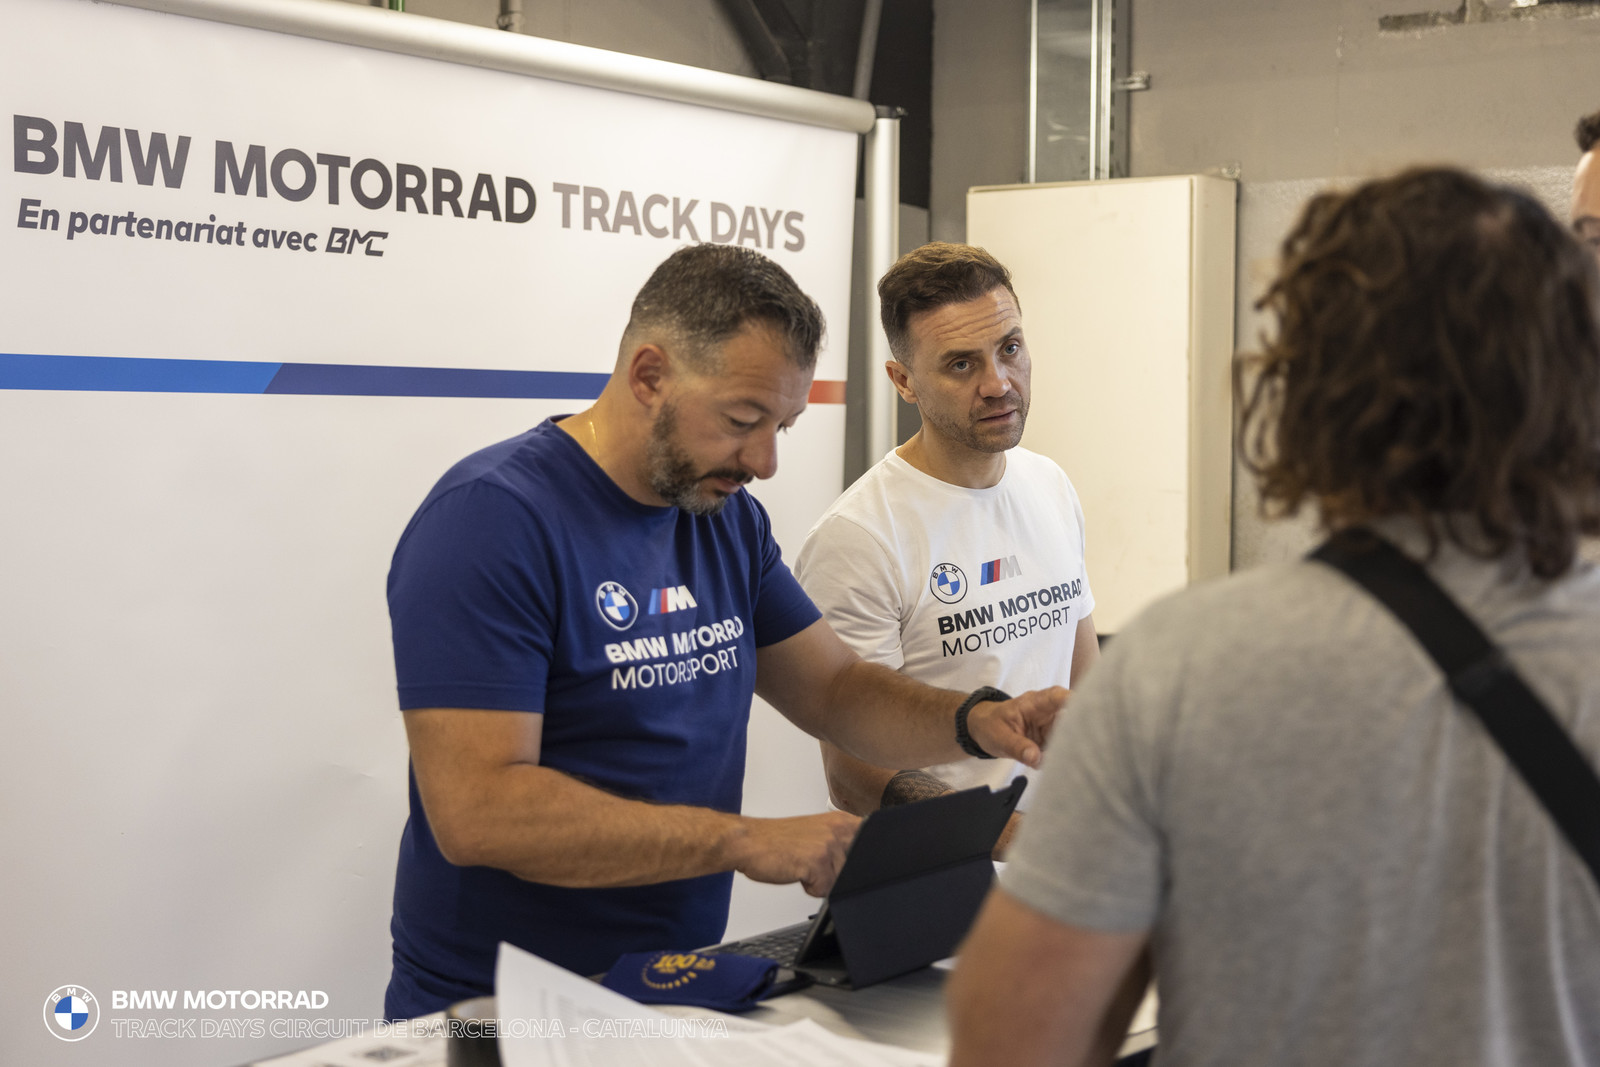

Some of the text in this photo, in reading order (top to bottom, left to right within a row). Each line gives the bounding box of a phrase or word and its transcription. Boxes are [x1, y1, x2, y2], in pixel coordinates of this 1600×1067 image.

[13, 114, 806, 252] BMW MOTORRAD TRACK DAYS
[17, 198, 389, 257] En partenariat avec BMC
[938, 578, 1082, 635] BMW MOTORRAD
[942, 606, 1070, 657] MOTORSPORT
[605, 616, 744, 663] BMW MTORRD
[612, 646, 738, 690] MOTORSPORT
